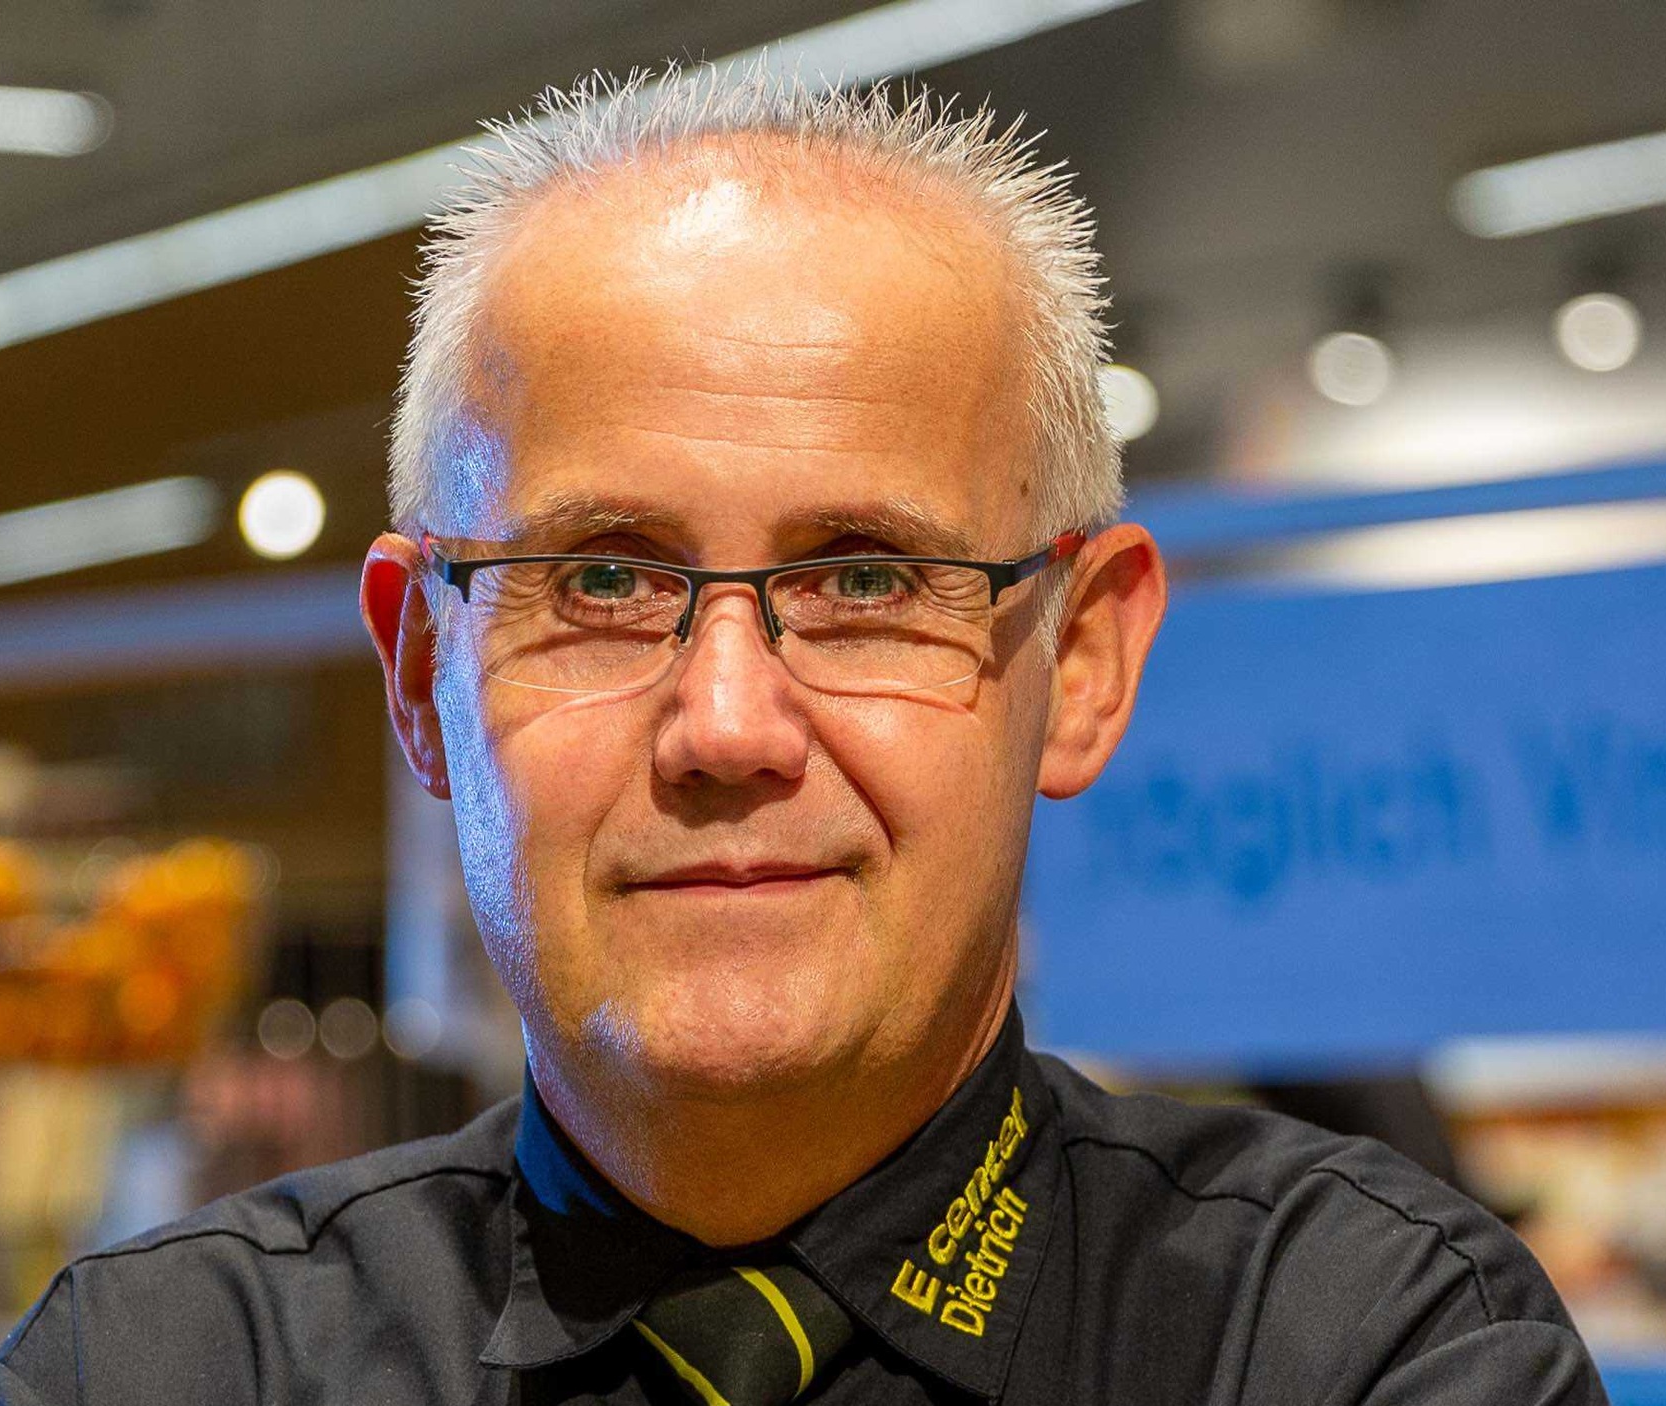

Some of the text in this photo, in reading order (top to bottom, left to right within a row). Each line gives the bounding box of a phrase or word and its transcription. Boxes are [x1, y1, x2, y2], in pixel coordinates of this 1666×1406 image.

[890, 1086, 1029, 1315] E center
[939, 1187, 1029, 1337] Dietrich
